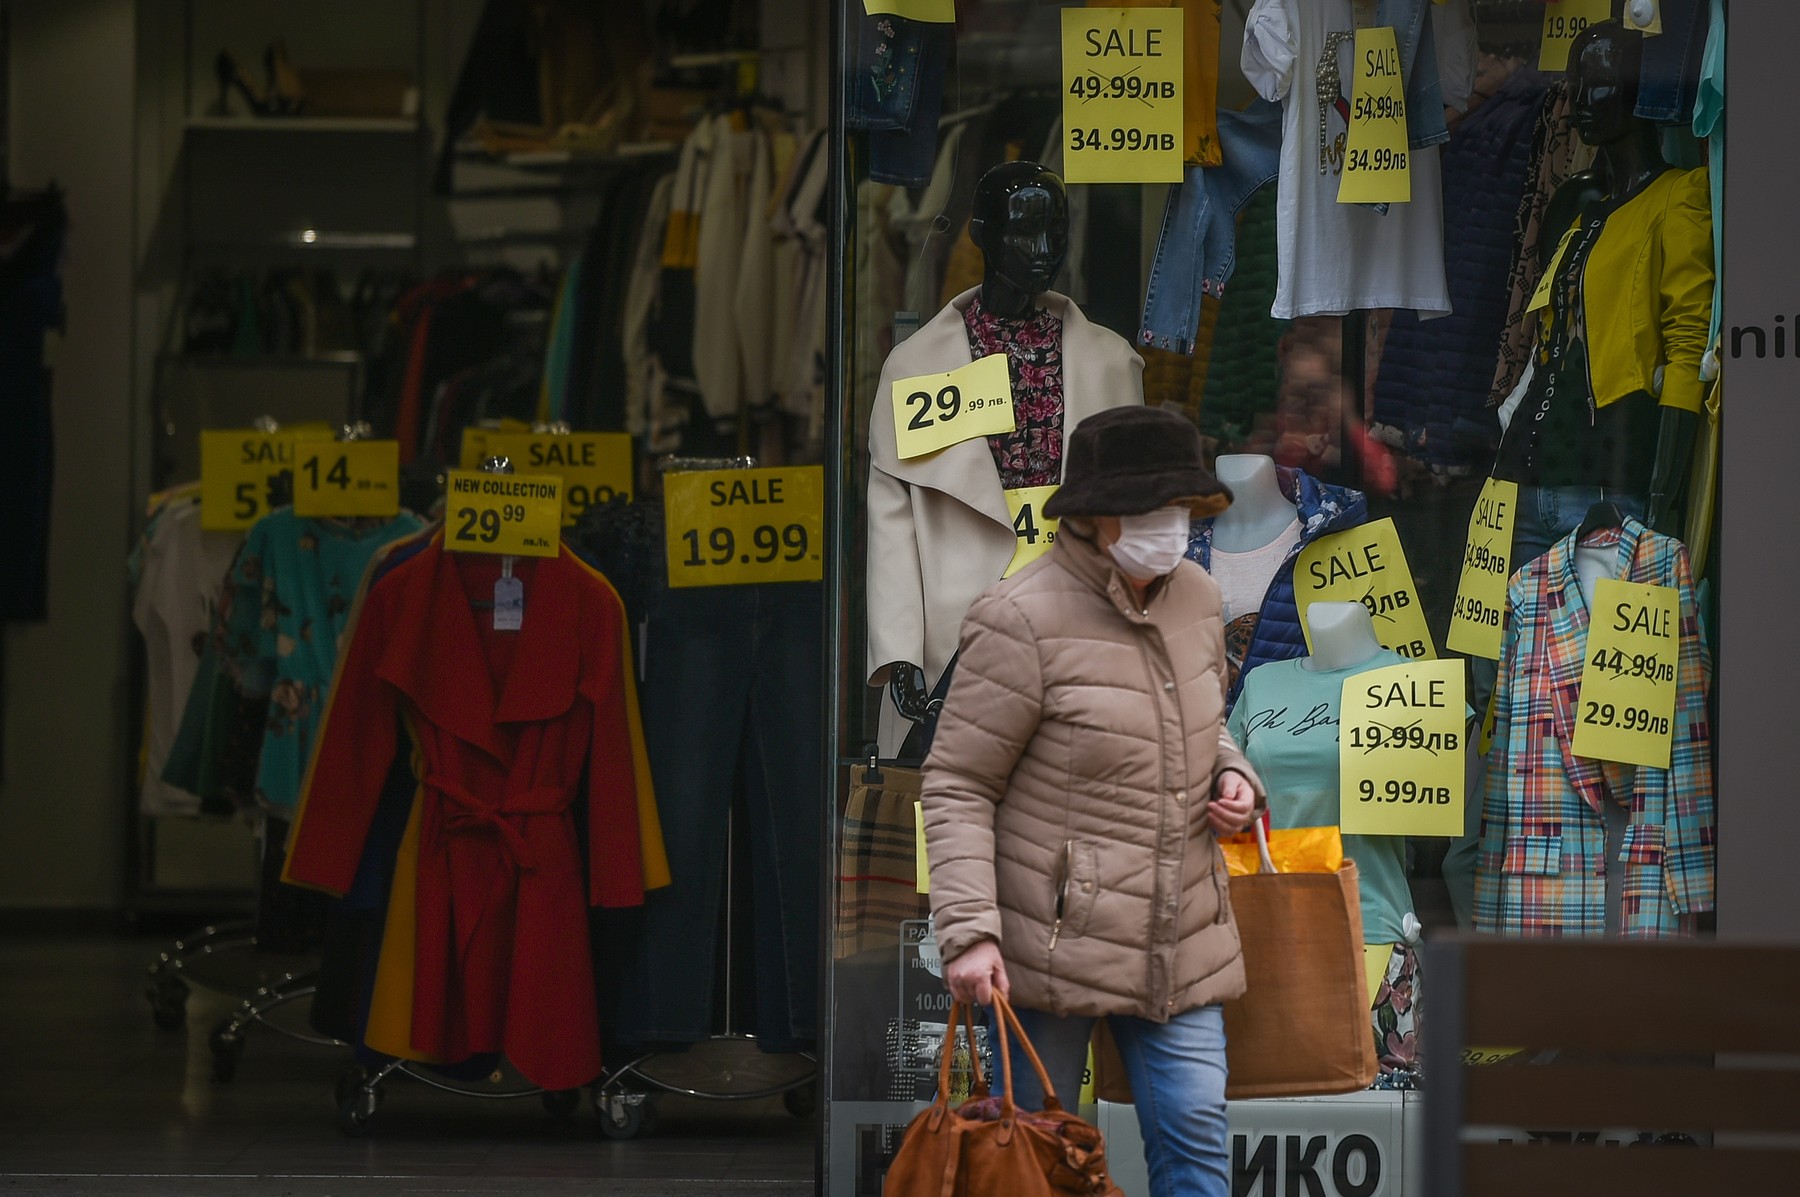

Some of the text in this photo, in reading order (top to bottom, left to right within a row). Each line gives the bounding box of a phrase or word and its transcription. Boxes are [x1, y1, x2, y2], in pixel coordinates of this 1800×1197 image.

[1546, 16, 1594, 39] 19.99
[1085, 29, 1162, 57] SALE
[1365, 48, 1397, 77] SALE
[1070, 76, 1175, 99] 49.99лв
[1354, 97, 1404, 119] 54.99лв
[1070, 128, 1175, 151] 34.99лв
[1347, 149, 1407, 171] 34.99лв
[241, 440, 294, 463] SAL
[530, 443, 595, 466] SALE
[454, 478, 556, 499] NEW COLLECTION
[710, 479, 784, 506] SALE
[1476, 498, 1505, 530] SALE
[682, 524, 808, 566] 19.99
[1310, 543, 1385, 589] SALE
[1614, 602, 1671, 638] SALE
[1592, 649, 1674, 682] 44.99лв
[1365, 680, 1445, 708] SALE
[1584, 701, 1669, 735] 29.99лв
[1350, 725, 1458, 750] 19.99лв
[1359, 779, 1450, 804] 9.99лв
